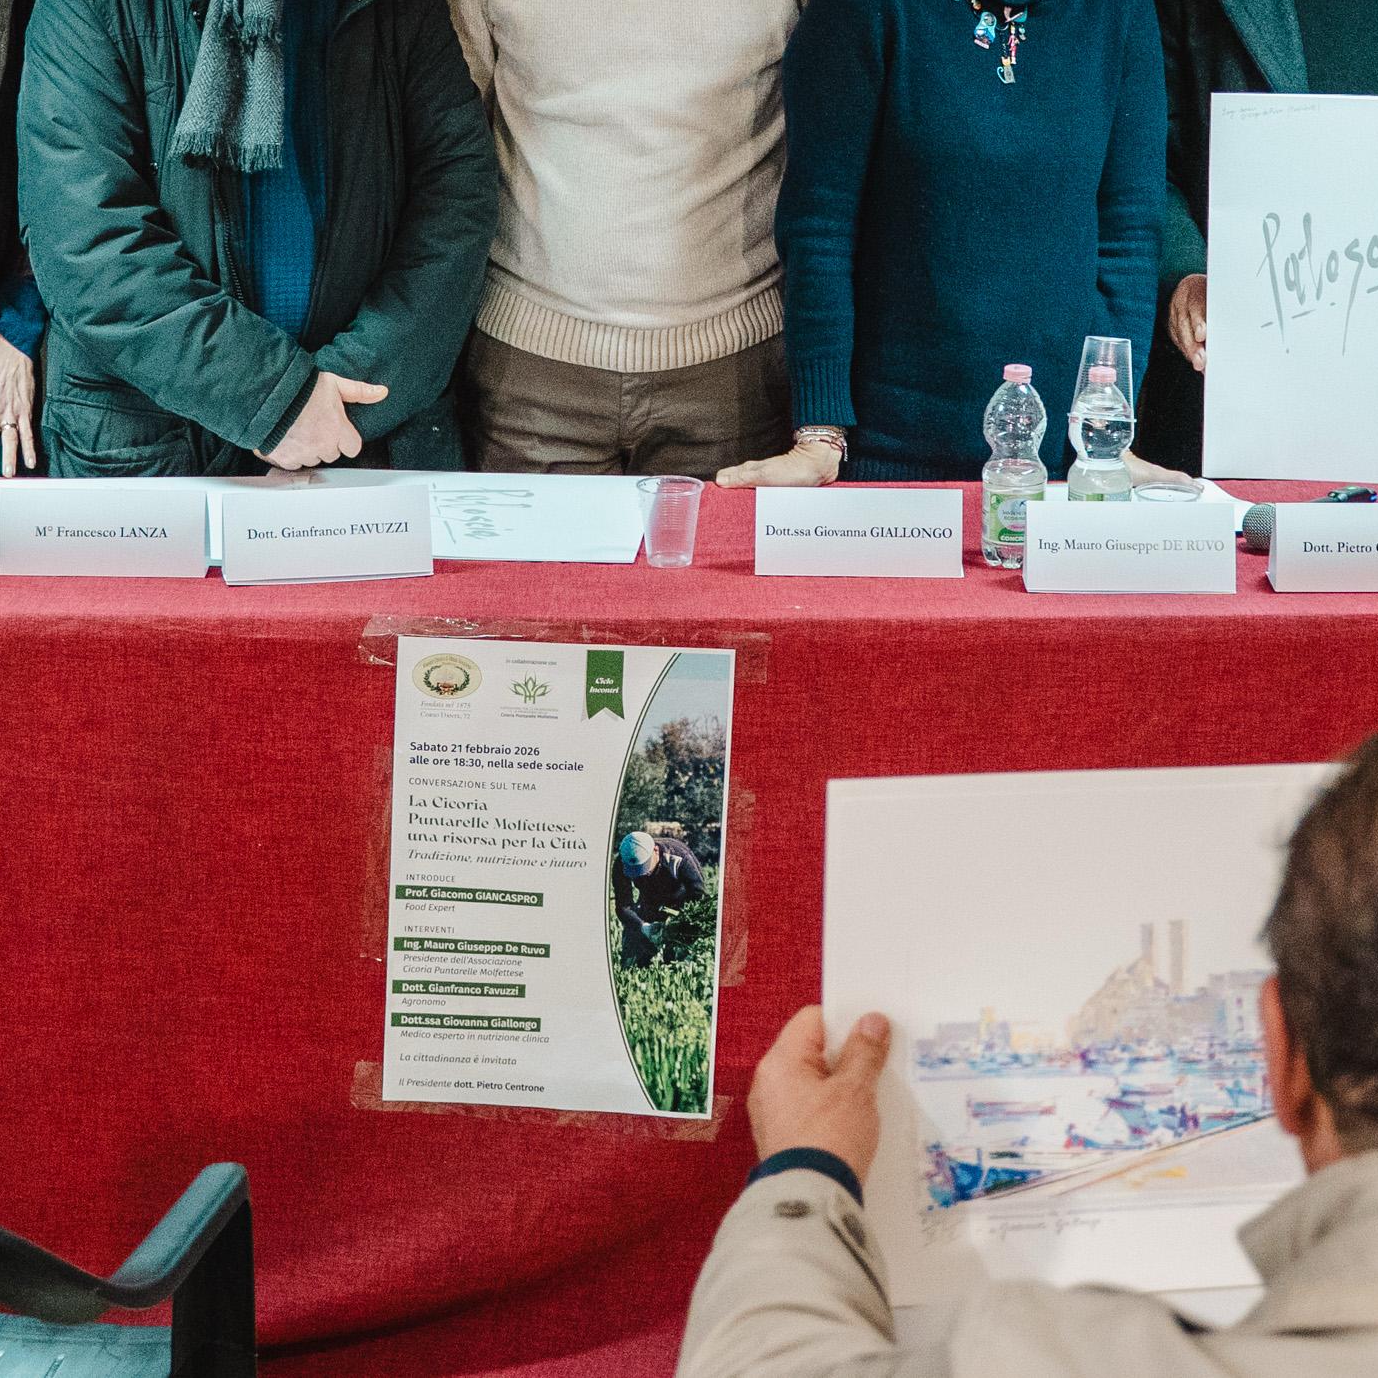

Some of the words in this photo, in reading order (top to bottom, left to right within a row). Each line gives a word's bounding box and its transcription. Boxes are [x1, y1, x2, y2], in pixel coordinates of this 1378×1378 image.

[57, 526, 117, 539] Francesco
[120, 527, 168, 539] LANZA
[247, 528, 278, 541] Dott.
[281, 525, 347, 539] Gianfranco
[350, 522, 410, 536] FAVUZZI
[765, 525, 811, 537] Dott.ssa
[814, 525, 867, 538] Giovanna
[870, 527, 952, 539] GIALLONGO
[1038, 539, 1061, 553] Ing.
[1063, 539, 1102, 551] Mauro
[1104, 539, 1160, 553] Giuseppe
[1163, 540, 1183, 551] DE
[1186, 540, 1225, 552] RUVO
[1303, 541, 1333, 554] Dott.
[1336, 541, 1373, 554] Pietro
[410, 741, 448, 753] Sabato
[451, 744, 462, 753] 21
[466, 744, 512, 755] febbraio
[514, 747, 540, 756] 2026
[409, 755, 429, 765] alle
[432, 758, 451, 766] ore
[454, 758, 484, 770] 18:30,
[487, 759, 514, 769] nella
[517, 760, 543, 770] sede
[546, 761, 584, 772] sociale
[408, 777, 487, 789] CONVERSAZIONE
[490, 782, 508, 790] SUL
[512, 783, 537, 791] TEMA
[409, 794, 427, 807] La
[432, 796, 488, 811] Cicoria
[409, 812, 489, 829] Puntarelle
[494, 817, 575, 833] Molfettese:
[407, 832, 438, 843] una
[443, 832, 497, 846] risorsa
[502, 838, 527, 849] per
[532, 837, 545, 849] la
[550, 837, 587, 850] Città
[408, 849, 473, 863] Tradizione,
[476, 854, 538, 867] nutrizione
[540, 860, 547, 868] e
[547, 858, 587, 869] futuro
[406, 874, 455, 883] INTRODUCE
[405, 888, 429, 898] Prof.
[430, 889, 474, 900] Giacomo
[475, 891, 538, 904] GIANCASPRO
[405, 903, 426, 911] Food
[428, 904, 455, 913] Expert
[404, 926, 455, 934] INTERVENTI
[403, 940, 422, 951] Ing.
[424, 940, 455, 951] Mauro
[457, 941, 503, 954] Giuseppe
[506, 944, 519, 953] De
[521, 945, 546, 955] Ruvo
[403, 954, 449, 964] Presidente
[403, 965, 432, 973] Cicoria
[434, 966, 478, 976] Puntarelle
[479, 968, 524, 978] Molfettese
[402, 983, 426, 992] Dott.
[429, 984, 482, 995] Gianfranco
[484, 986, 519, 996] Favuzzi
[401, 997, 446, 1007] Agronomo
[401, 1015, 441, 1025] Dott.ssa
[443, 1017, 489, 1028] Giovanna
[491, 1018, 538, 1031] Giallongo
[400, 1030, 431, 1039] Medico
[433, 1033, 465, 1042] esperto
[467, 1033, 475, 1041] in
[477, 1034, 520, 1042] nutrizione
[522, 1034, 550, 1043] clinica
[400, 1053, 411, 1062] La
[413, 1054, 471, 1064] cittadinanza
[481, 1056, 517, 1065] invitata
[399, 1078, 405, 1086] Il
[406, 1078, 452, 1088] Presidente
[454, 1080, 474, 1089] dott.
[477, 1081, 503, 1090] Pietro
[505, 1082, 545, 1092] Centrone
